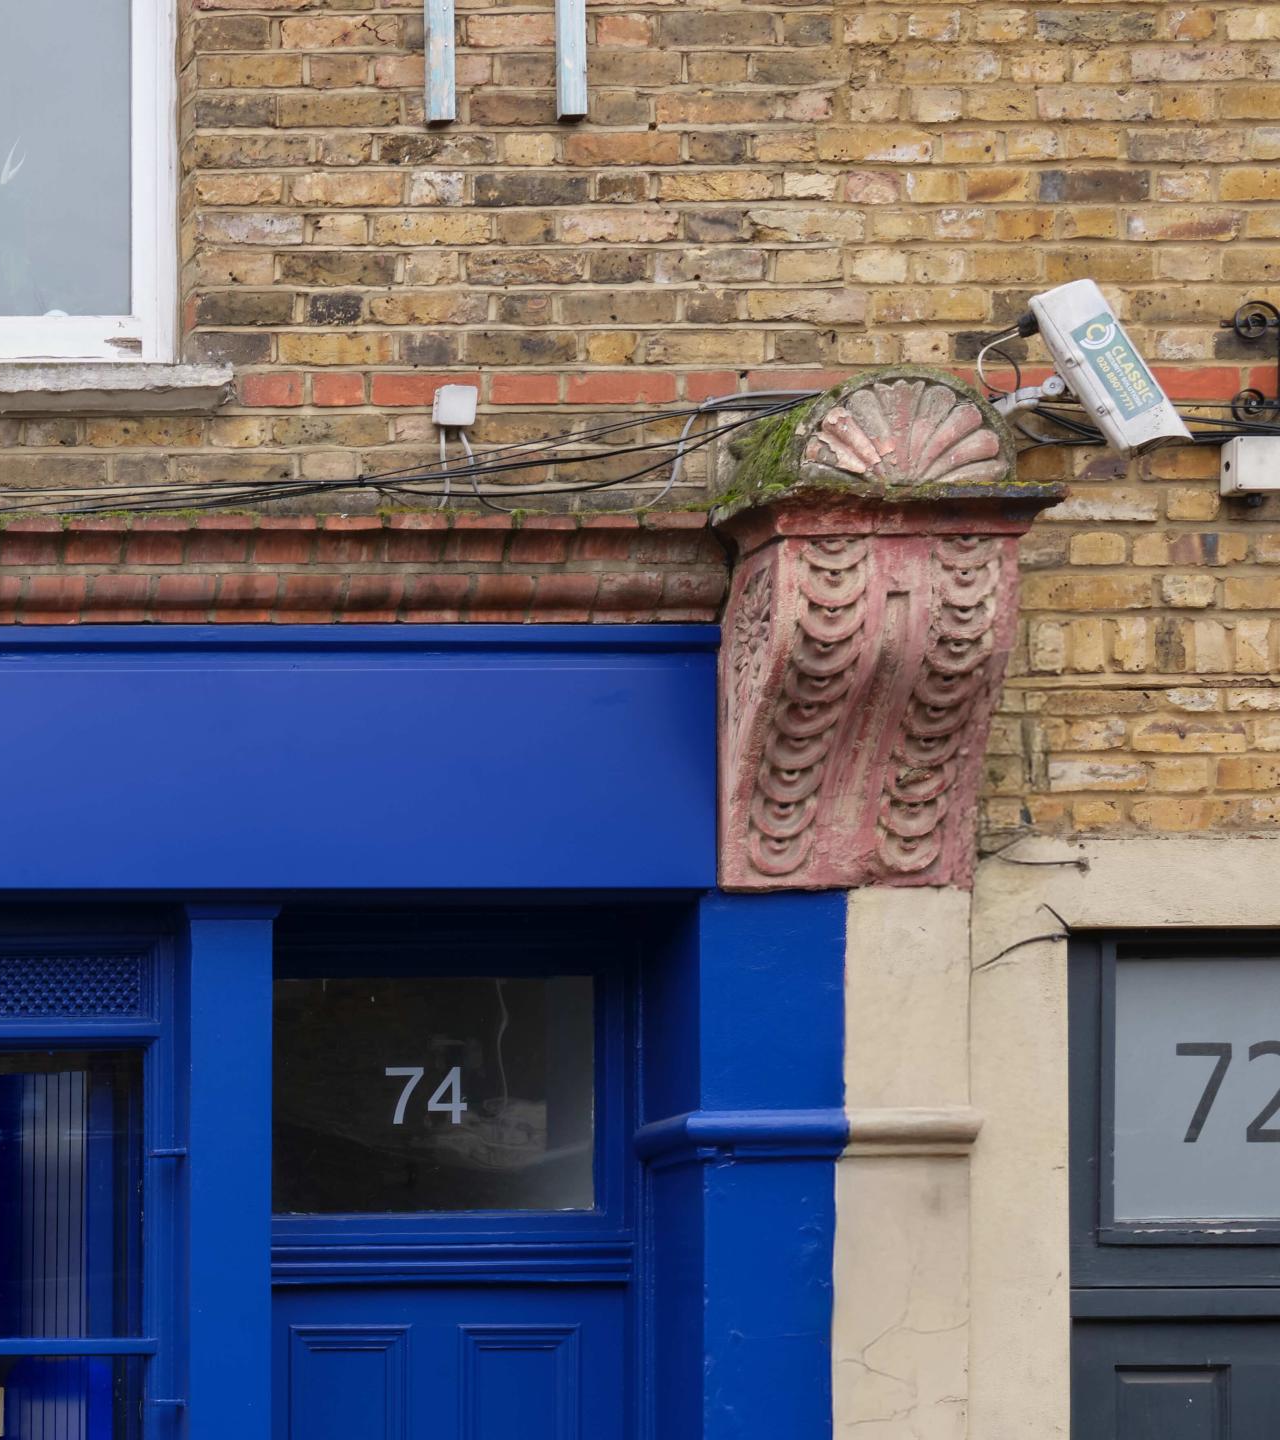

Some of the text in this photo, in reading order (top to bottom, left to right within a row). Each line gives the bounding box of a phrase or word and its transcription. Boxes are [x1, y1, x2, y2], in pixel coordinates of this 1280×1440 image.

[1096, 356, 1110, 372] 020
[1111, 345, 1154, 403] CLASSIC
[385, 1067, 468, 1125] 74
[1176, 1040, 1280, 1143] 72
